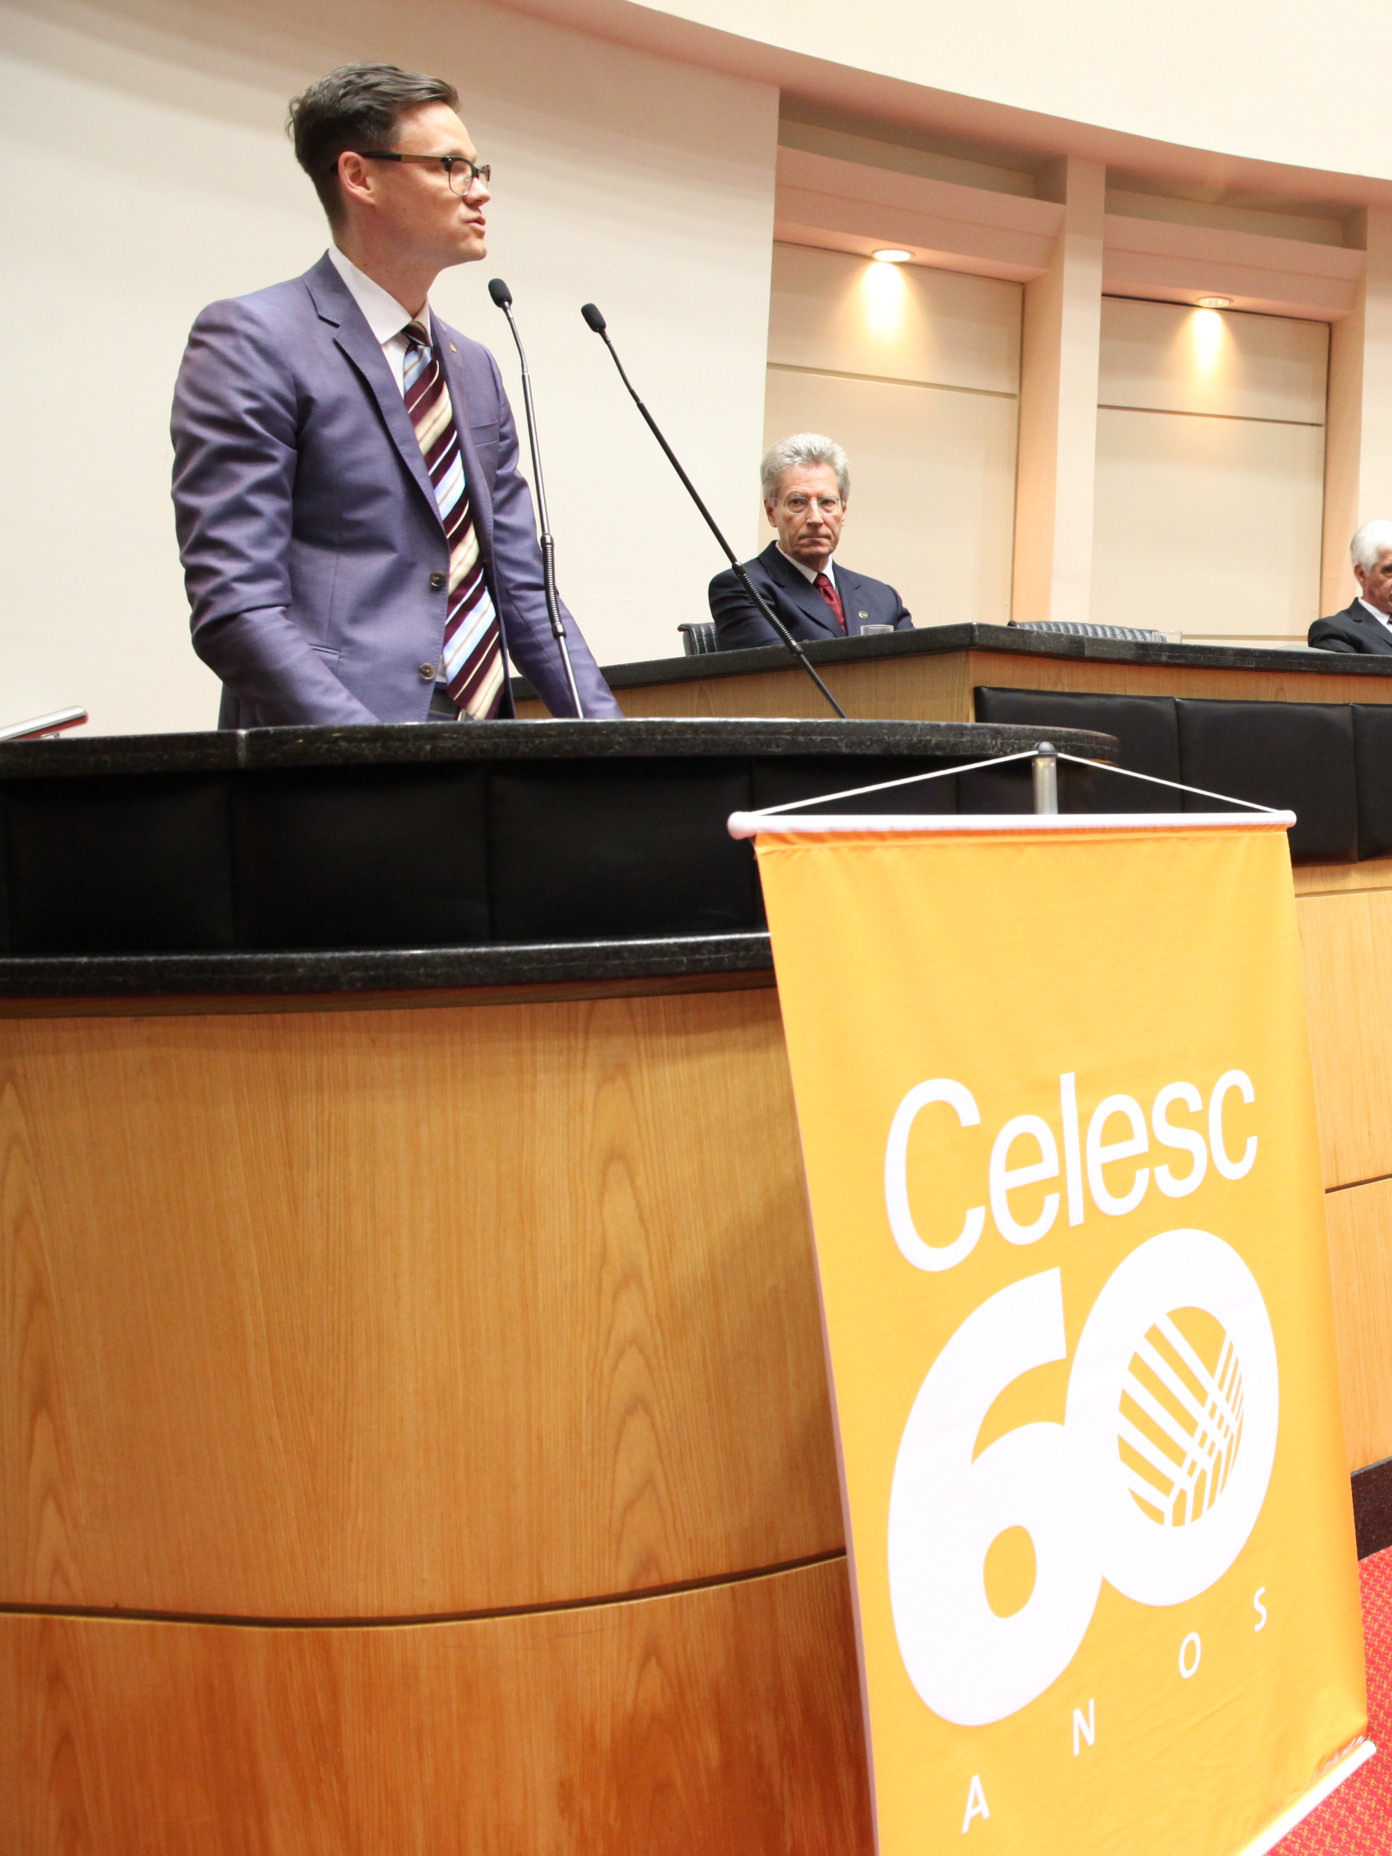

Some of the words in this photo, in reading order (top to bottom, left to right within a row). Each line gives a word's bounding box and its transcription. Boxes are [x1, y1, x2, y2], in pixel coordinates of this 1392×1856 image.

[883, 1069, 1259, 1273] Celesc
[886, 1228, 1280, 1727] 60
[960, 1586, 1269, 1835] ANOS
